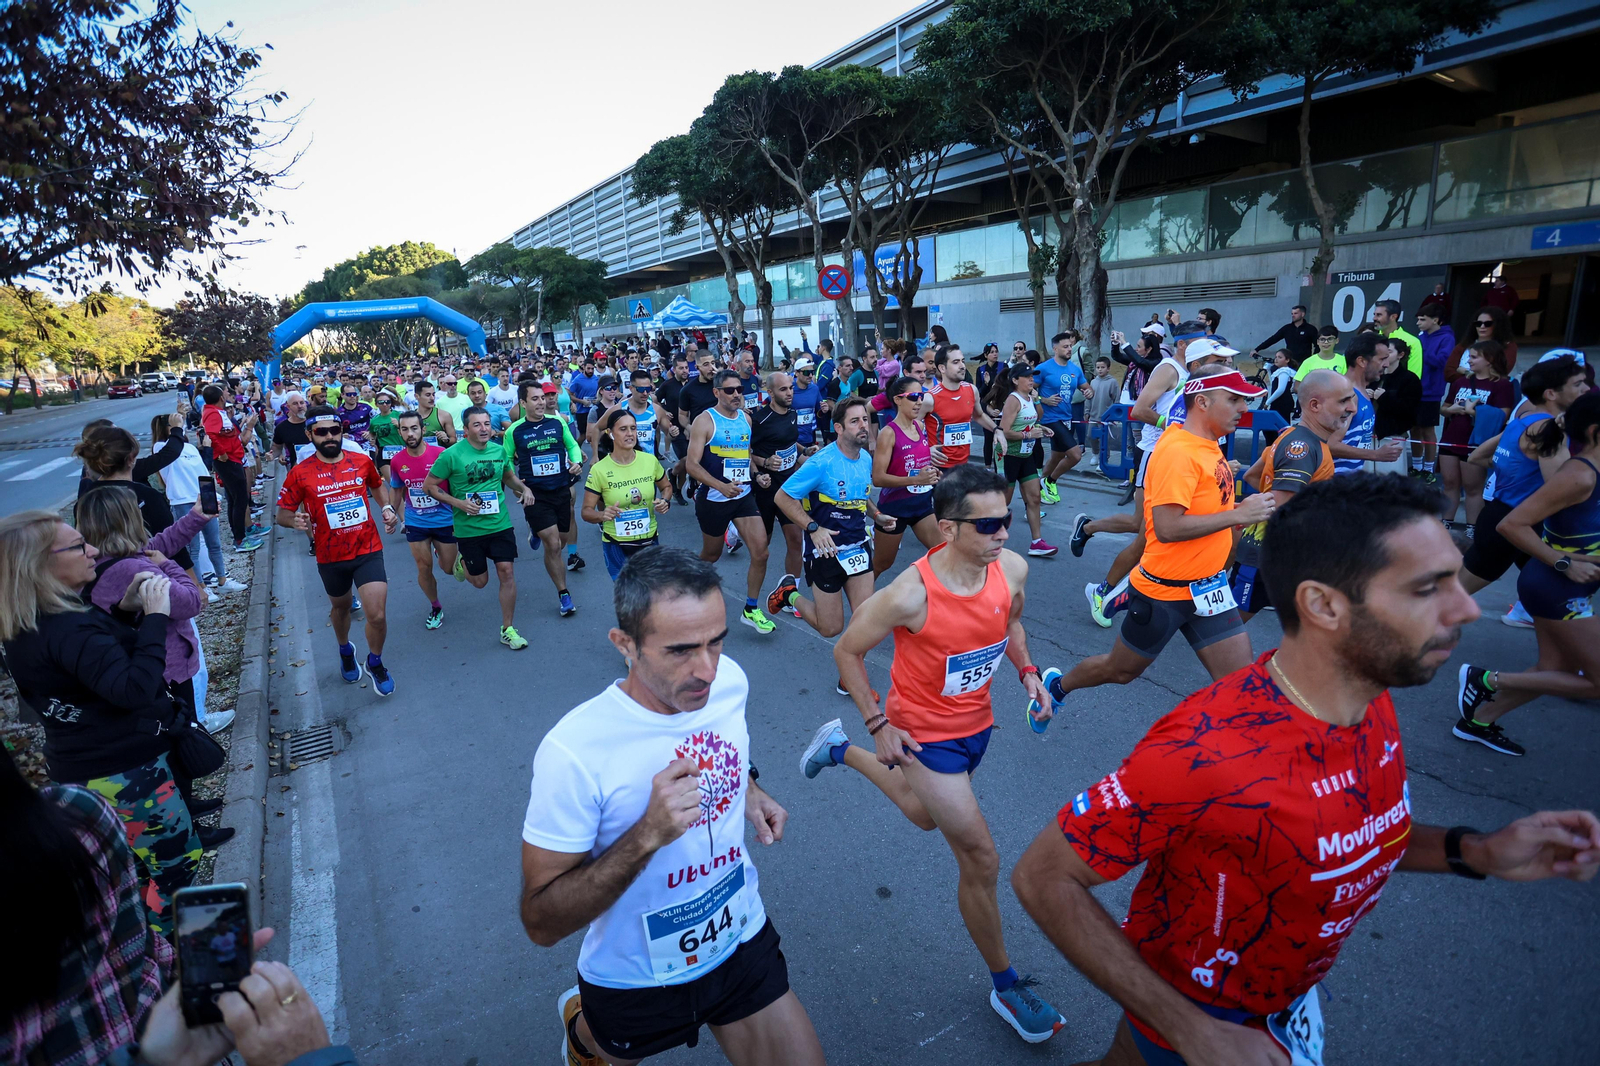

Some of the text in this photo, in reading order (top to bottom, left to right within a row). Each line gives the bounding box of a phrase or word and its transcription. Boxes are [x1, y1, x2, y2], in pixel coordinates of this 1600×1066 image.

[1545, 228, 1562, 246] 4
[885, 265, 902, 276] Jerz
[1338, 271, 1376, 283] Tribuna
[866, 377, 878, 385] FILA
[950, 431, 966, 442] 506
[539, 462, 555, 472] 192
[731, 468, 746, 478] 124
[317, 479, 356, 492] Movijerez
[607, 475, 653, 490] Paparunners
[415, 496, 432, 504] 415
[337, 509, 360, 523] 386
[623, 519, 644, 532] 256
[847, 554, 867, 568] 992
[1203, 589, 1224, 608] 140
[961, 661, 993, 687] 555
[1311, 769, 1356, 798] GOBIK
[1317, 799, 1406, 862] Movijerez
[662, 907, 682, 919] XLIII
[683, 893, 712, 911] Carrera
[712, 870, 737, 893] Popular
[672, 909, 703, 924] Ciudad
[704, 902, 713, 911] de
[713, 886, 730, 903] Jerez
[678, 904, 734, 954] 644
